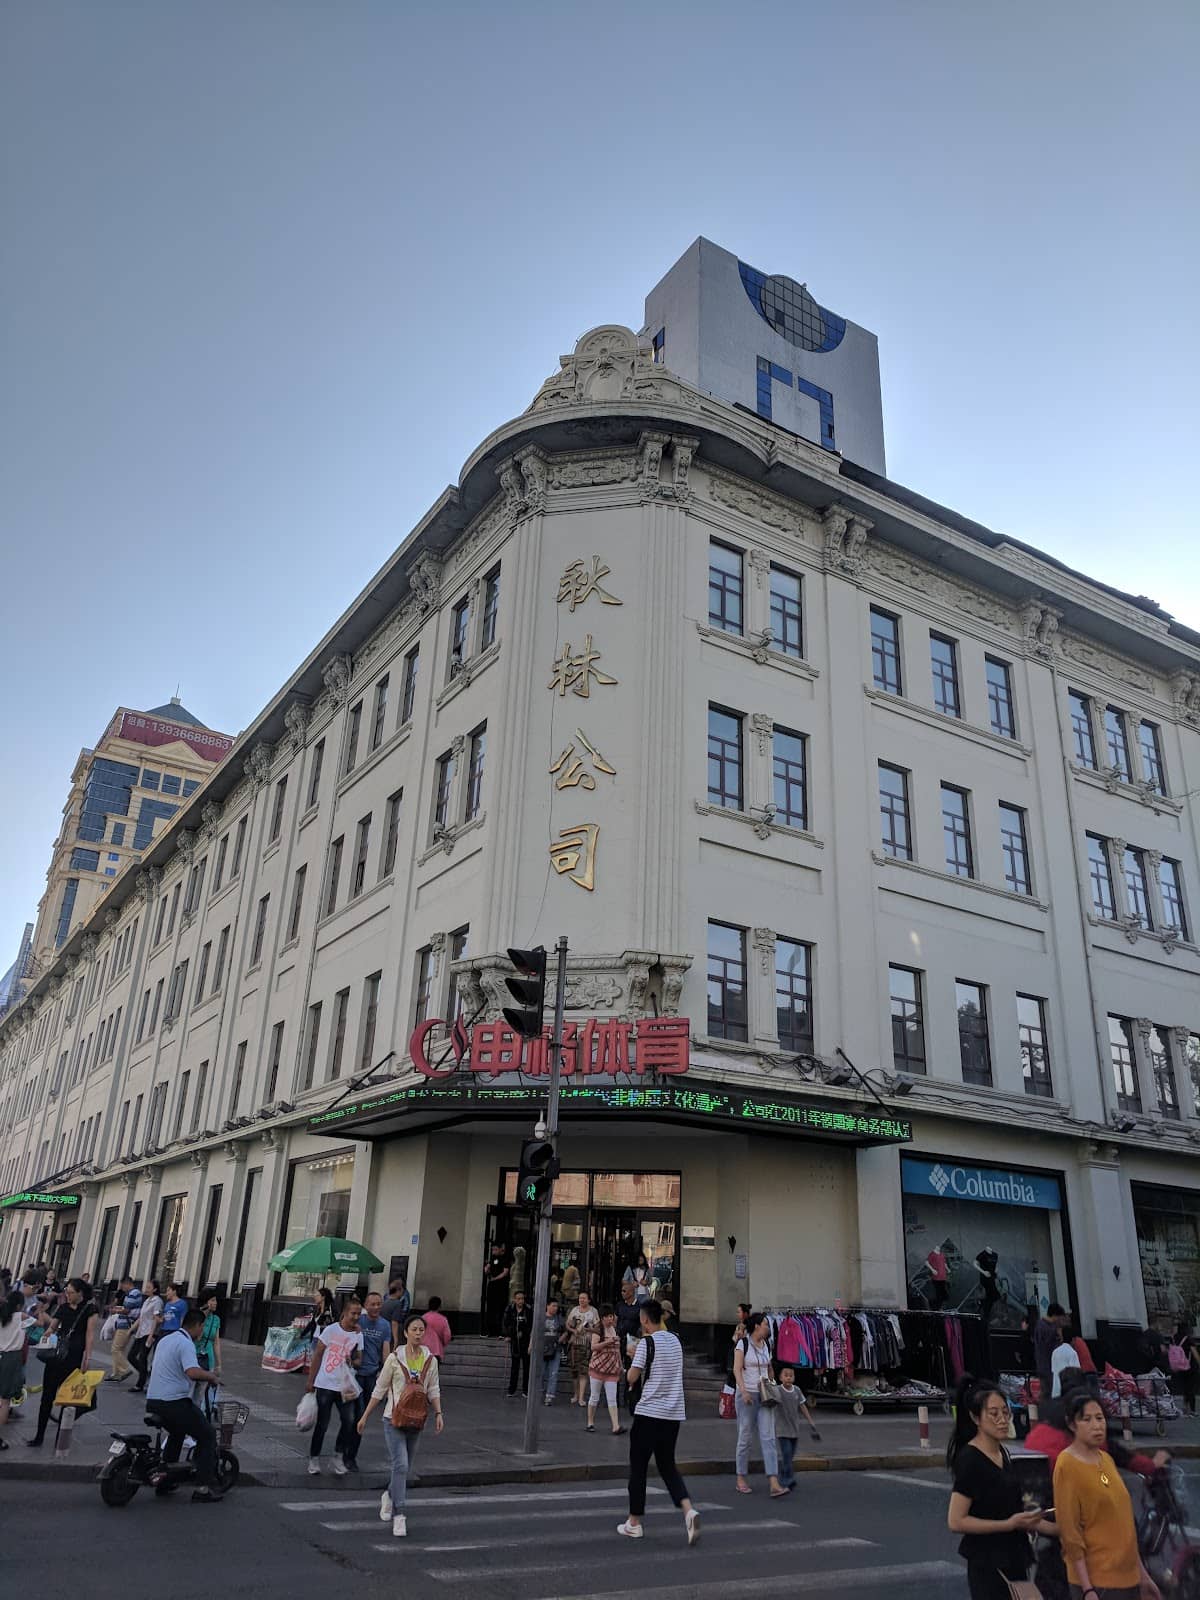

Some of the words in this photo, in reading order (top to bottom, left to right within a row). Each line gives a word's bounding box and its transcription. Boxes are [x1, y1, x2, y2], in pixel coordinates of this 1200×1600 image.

[549, 555, 623, 891] 秋林公司
[951, 1168, 1035, 1203] Columbia
